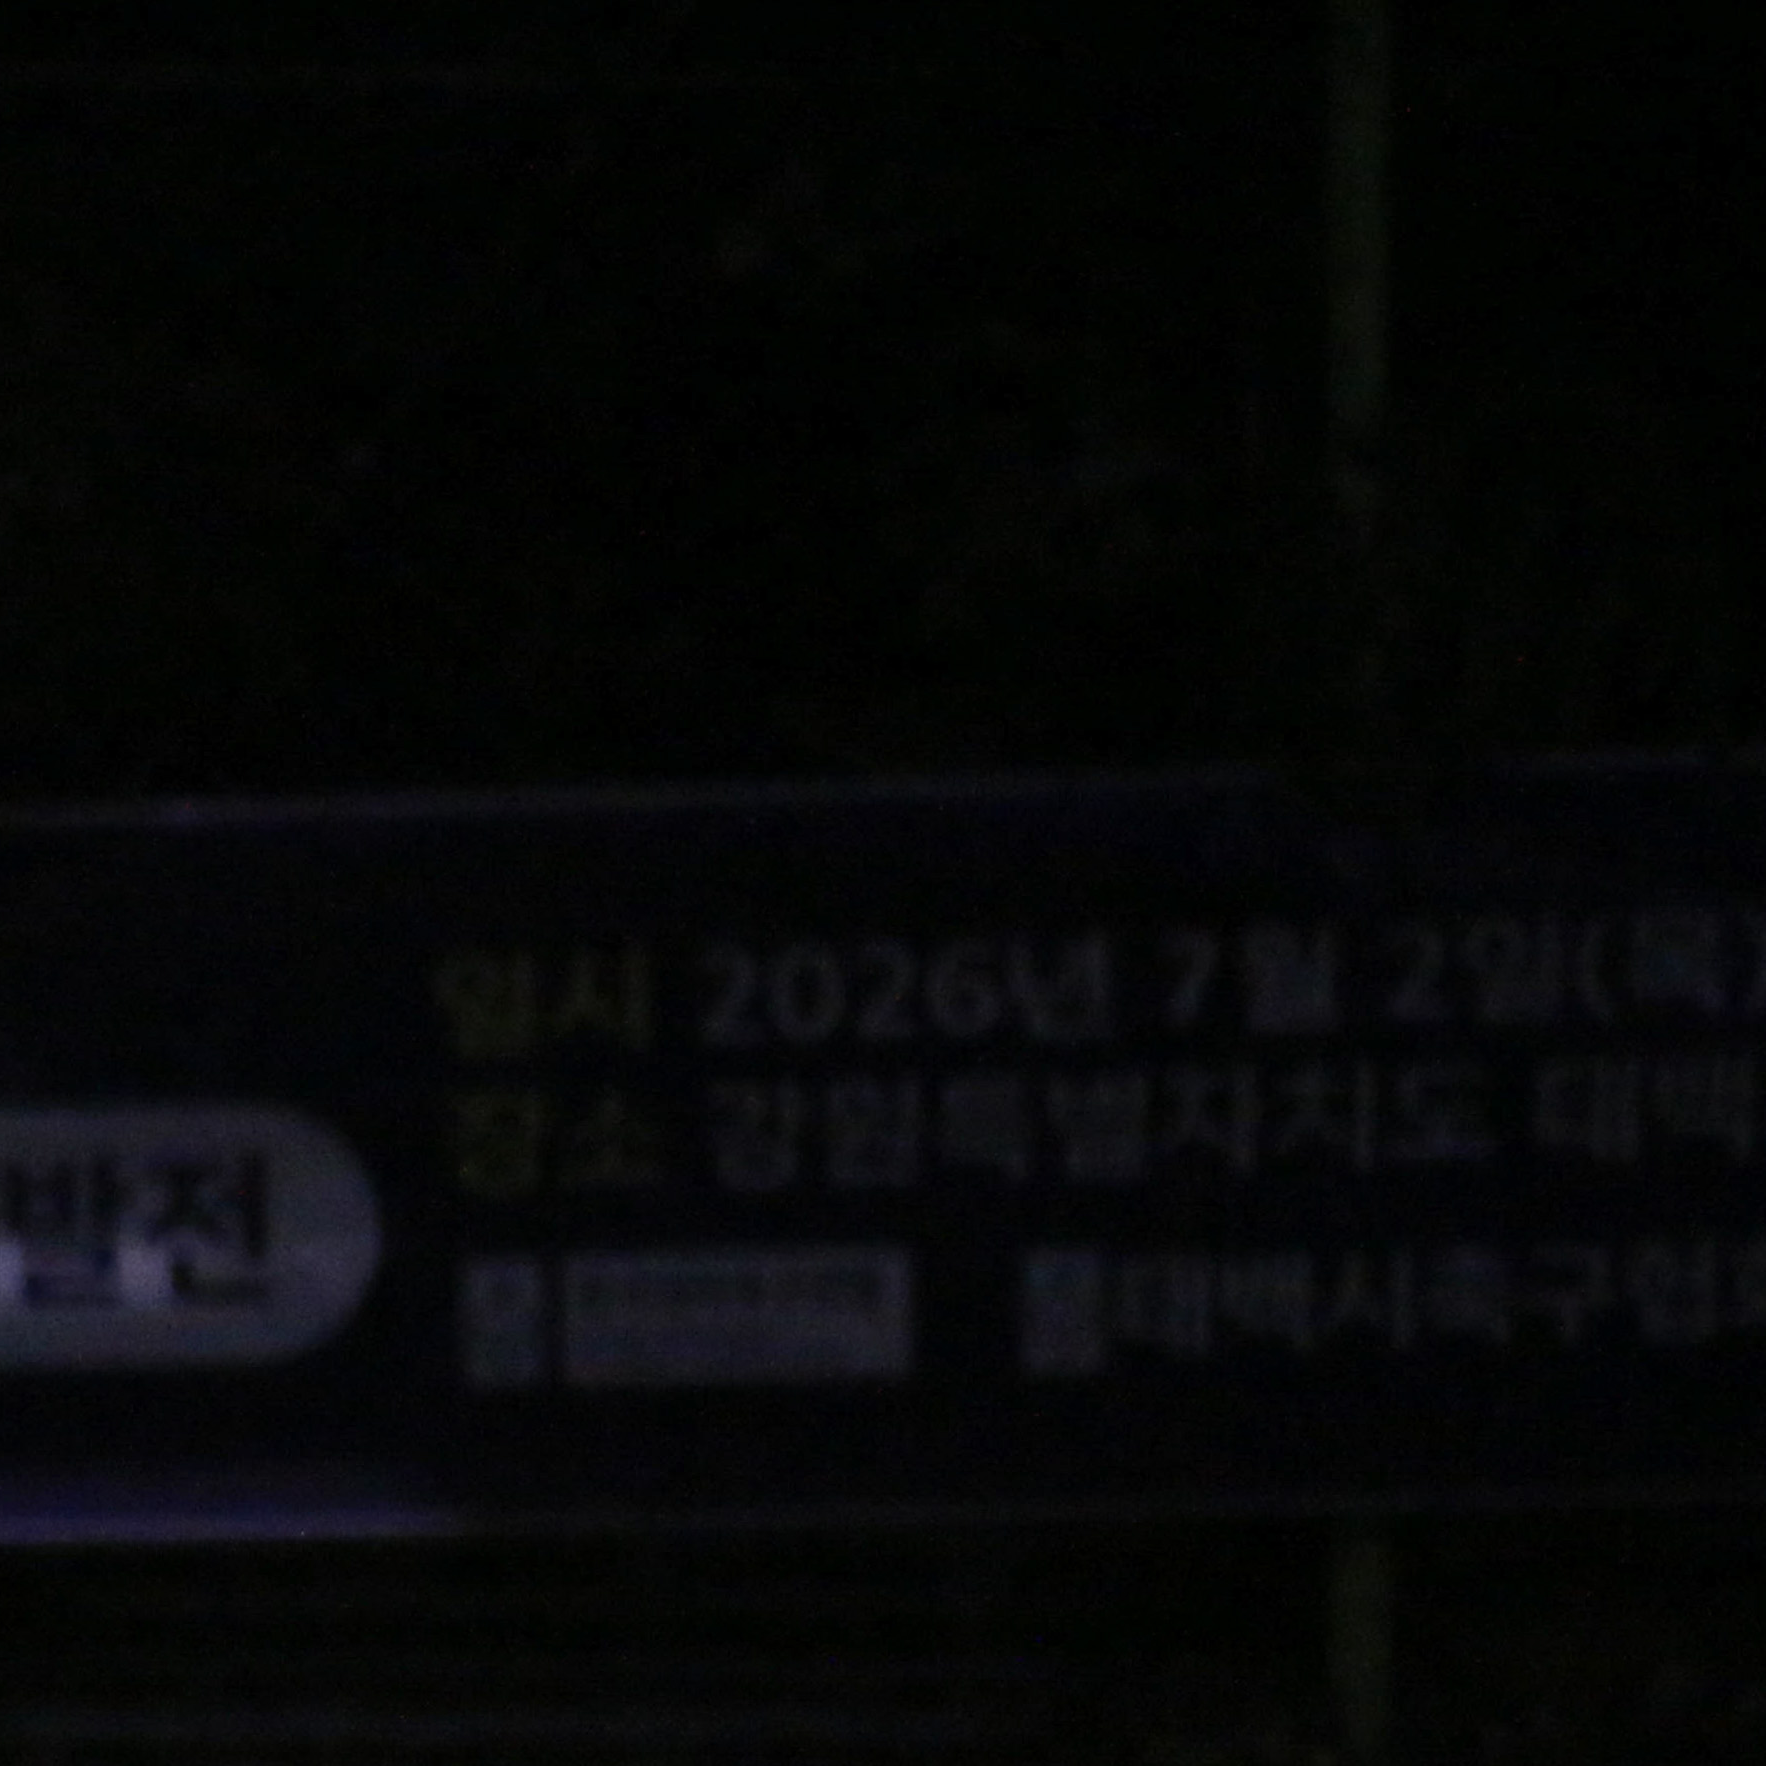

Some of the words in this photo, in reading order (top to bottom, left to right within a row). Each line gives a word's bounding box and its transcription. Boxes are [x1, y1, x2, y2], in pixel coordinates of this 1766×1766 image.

[434, 944, 652, 1056] 일시
[700, 932, 1116, 1044] 2026년
[1158, 918, 1340, 1032] 7월
[453, 1086, 668, 1198] 장소
[706, 1062, 1496, 1192] 강원특별자치도
